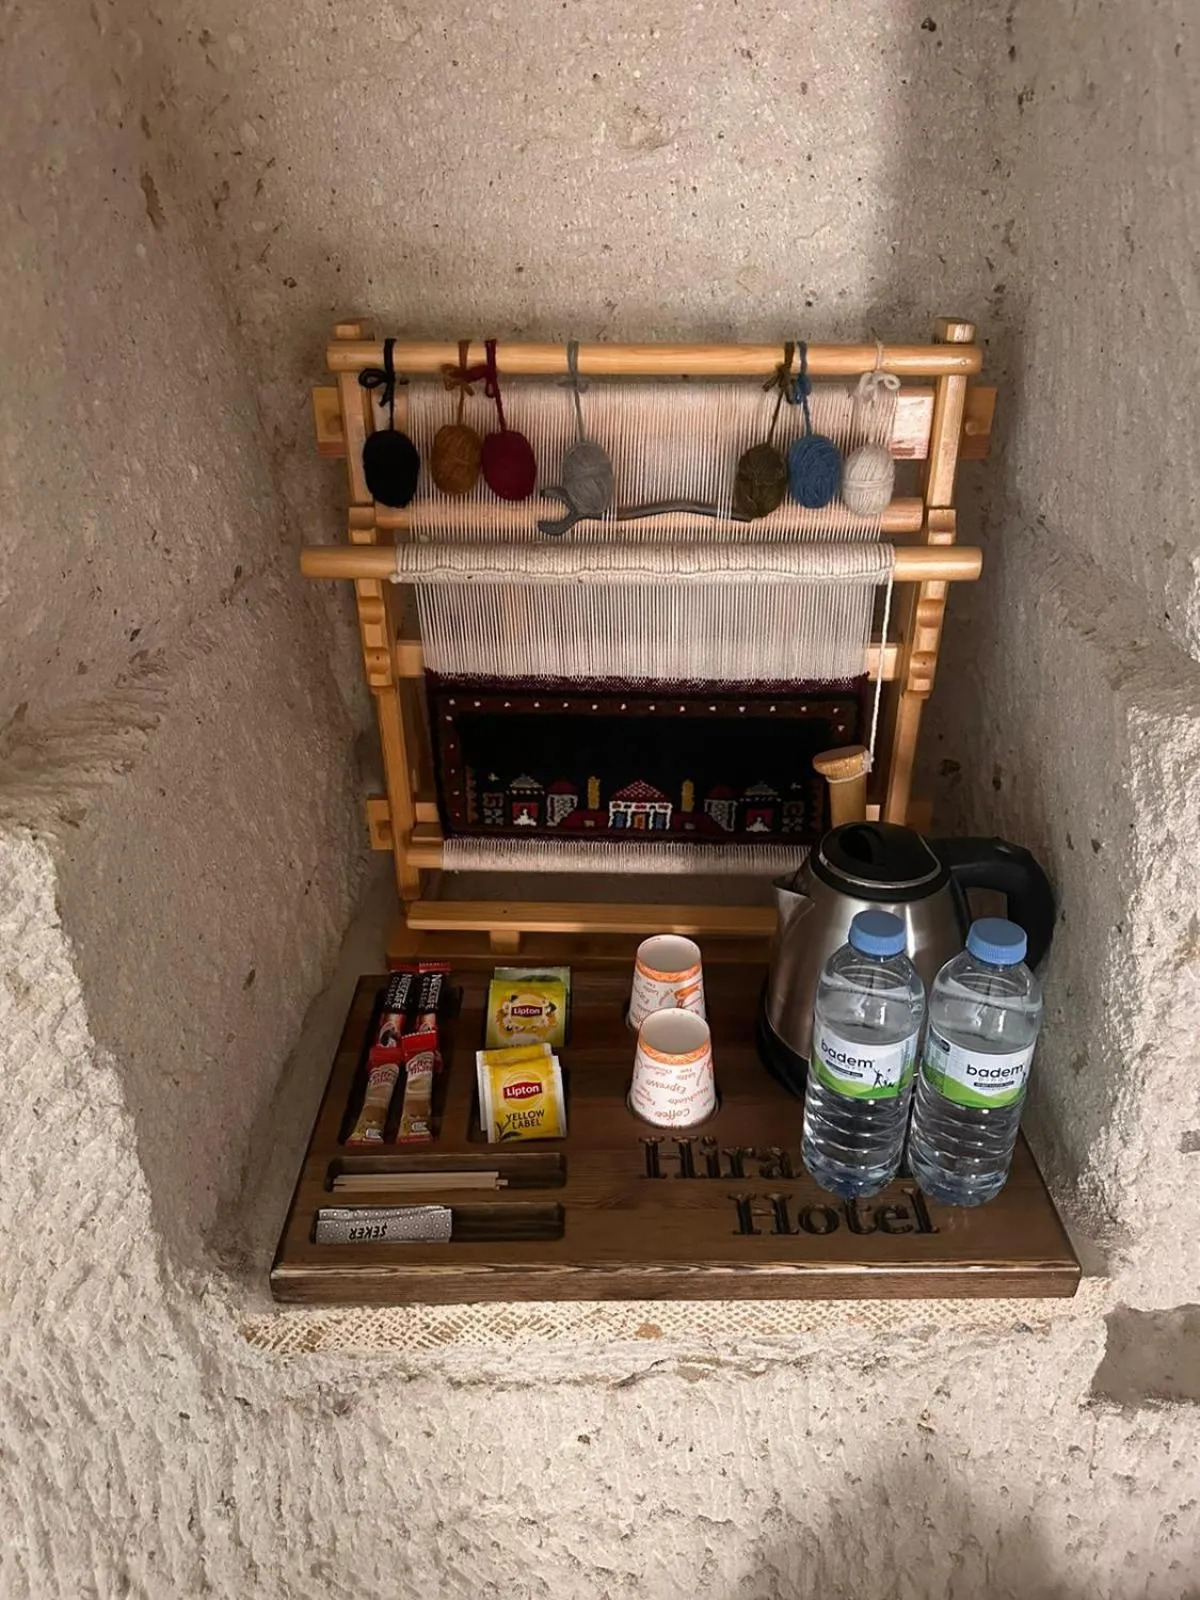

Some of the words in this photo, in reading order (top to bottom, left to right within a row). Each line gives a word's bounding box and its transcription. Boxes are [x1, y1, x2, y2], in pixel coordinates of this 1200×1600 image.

[513, 1006, 541, 1015] Lipton
[820, 1038, 873, 1068] badem
[966, 1063, 1024, 1078] badem
[506, 1085, 540, 1097] Lipton
[505, 1109, 545, 1121] YELLOW
[654, 1107, 690, 1120] Coffee
[512, 1119, 542, 1130] LABEL
[638, 1135, 802, 1179] Hira
[727, 1187, 941, 1236] Hotel
